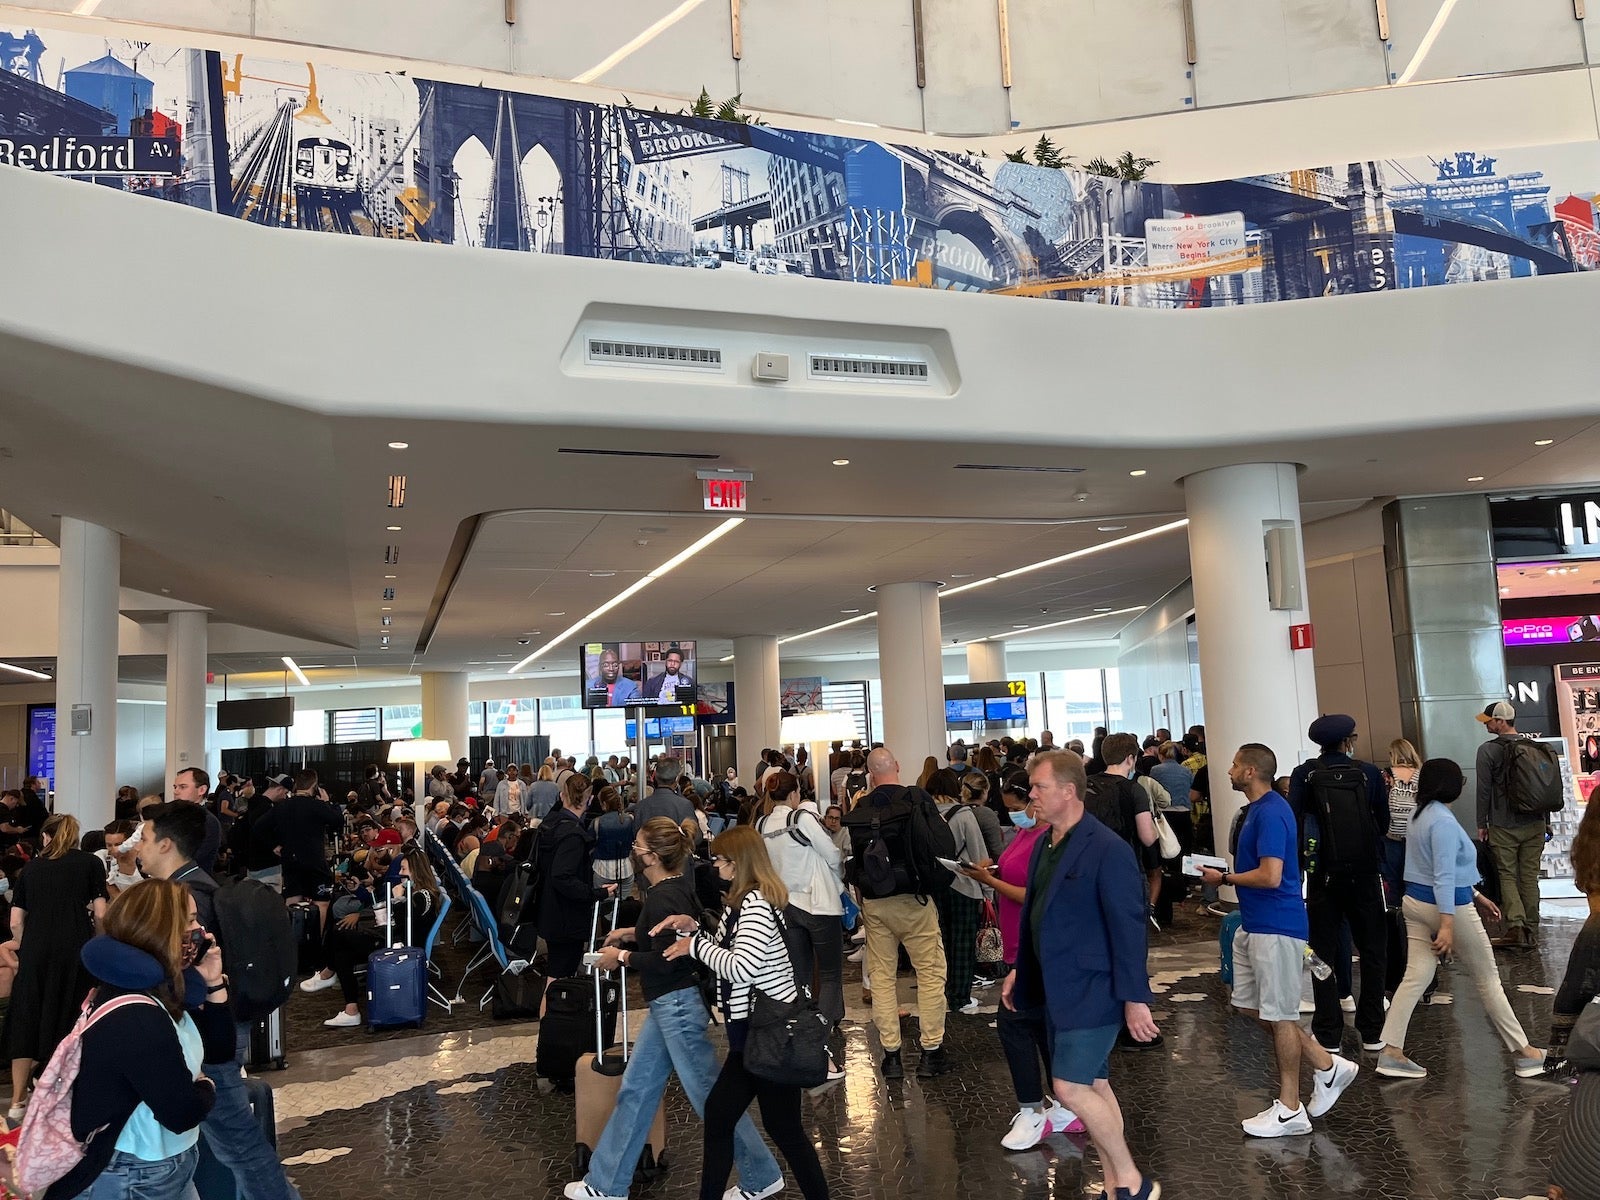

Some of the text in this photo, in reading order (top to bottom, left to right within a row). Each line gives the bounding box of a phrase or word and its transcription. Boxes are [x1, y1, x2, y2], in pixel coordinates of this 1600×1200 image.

[640, 130, 732, 155] BROOKL
[1198, 219, 1236, 230] Brooklyn
[1197, 240, 1215, 248] York
[1220, 238, 1238, 246] City
[1180, 250, 1211, 260] Begins!
[709, 481, 743, 508] EXIT
[1572, 667, 1584, 675] BE
[1008, 681, 1026, 696] 12
[680, 703, 695, 715] 11
